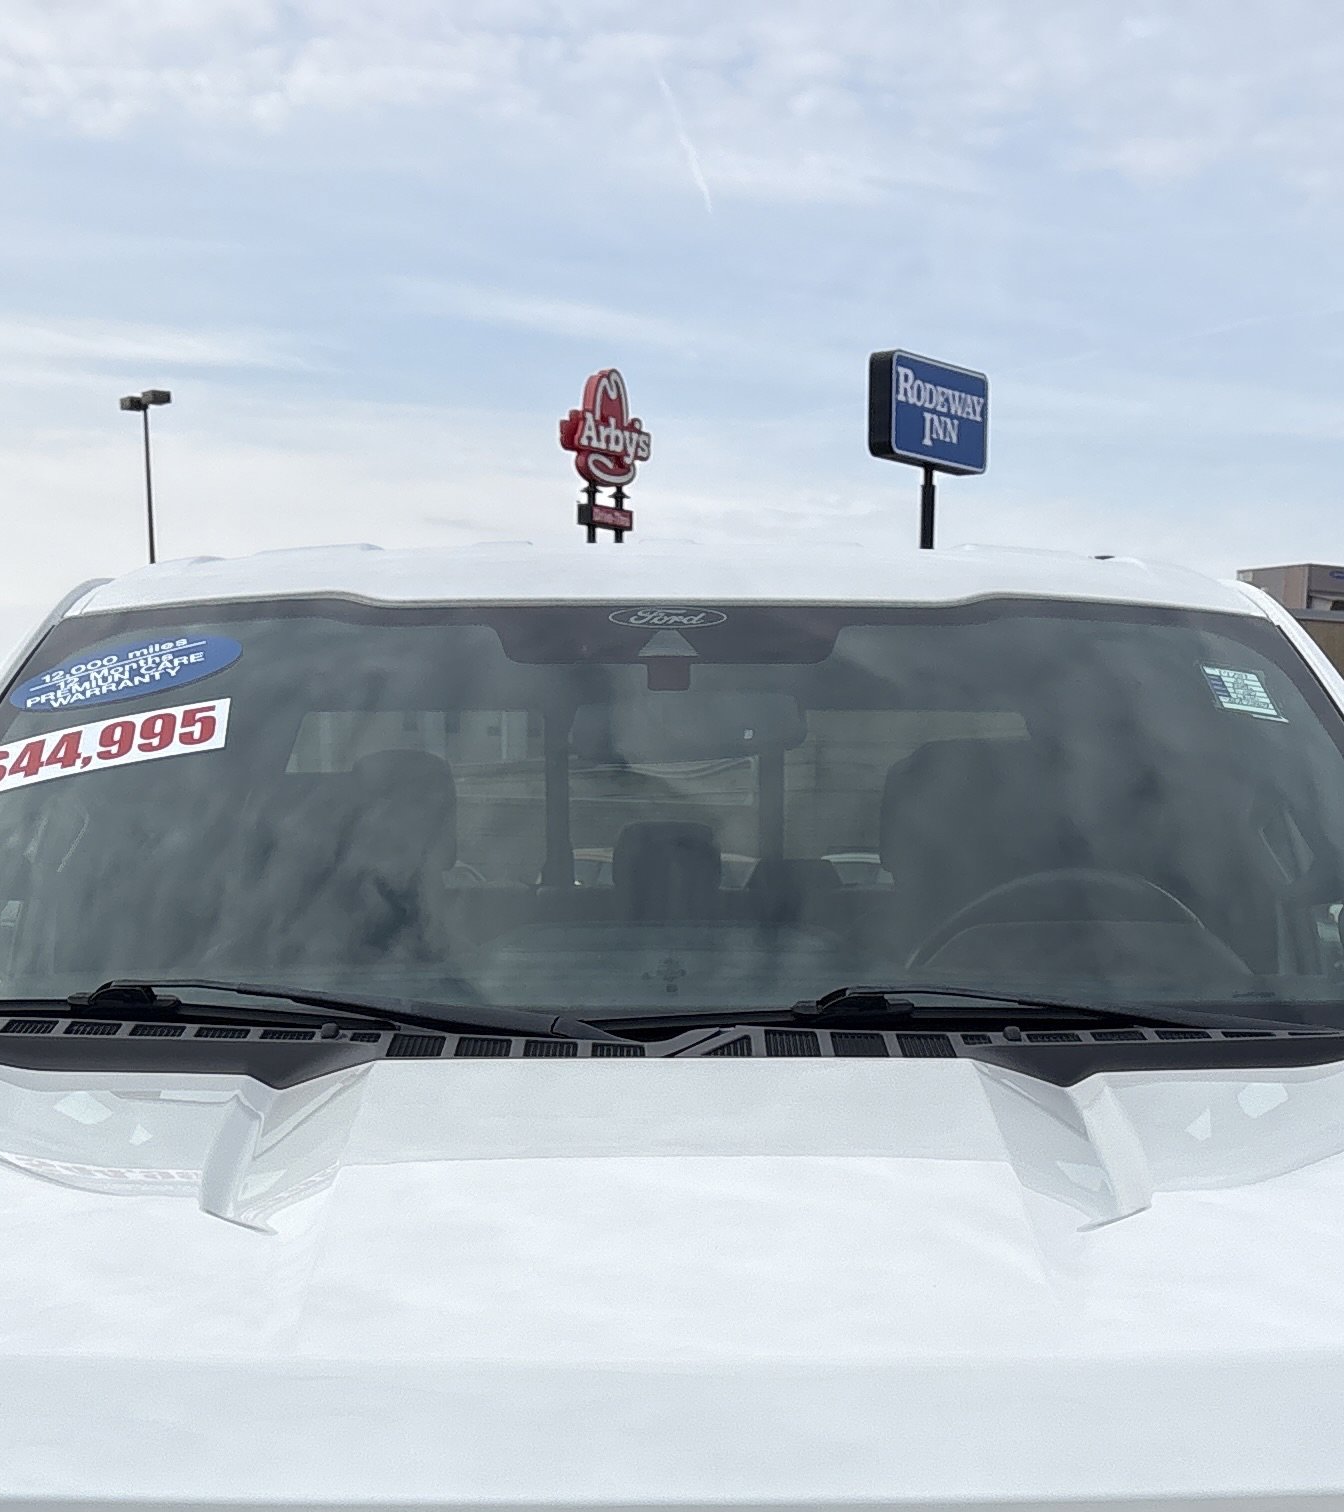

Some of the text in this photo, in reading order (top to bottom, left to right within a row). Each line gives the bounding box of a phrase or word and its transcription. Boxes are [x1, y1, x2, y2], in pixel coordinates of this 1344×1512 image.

[897, 366, 984, 422] RODEWAY
[579, 411, 650, 464] Arby's
[922, 411, 959, 446] INN
[630, 608, 706, 624] Ford
[128, 638, 188, 659] miles
[140, 651, 205, 675] CARE
[50, 666, 180, 708] WARRANTY
